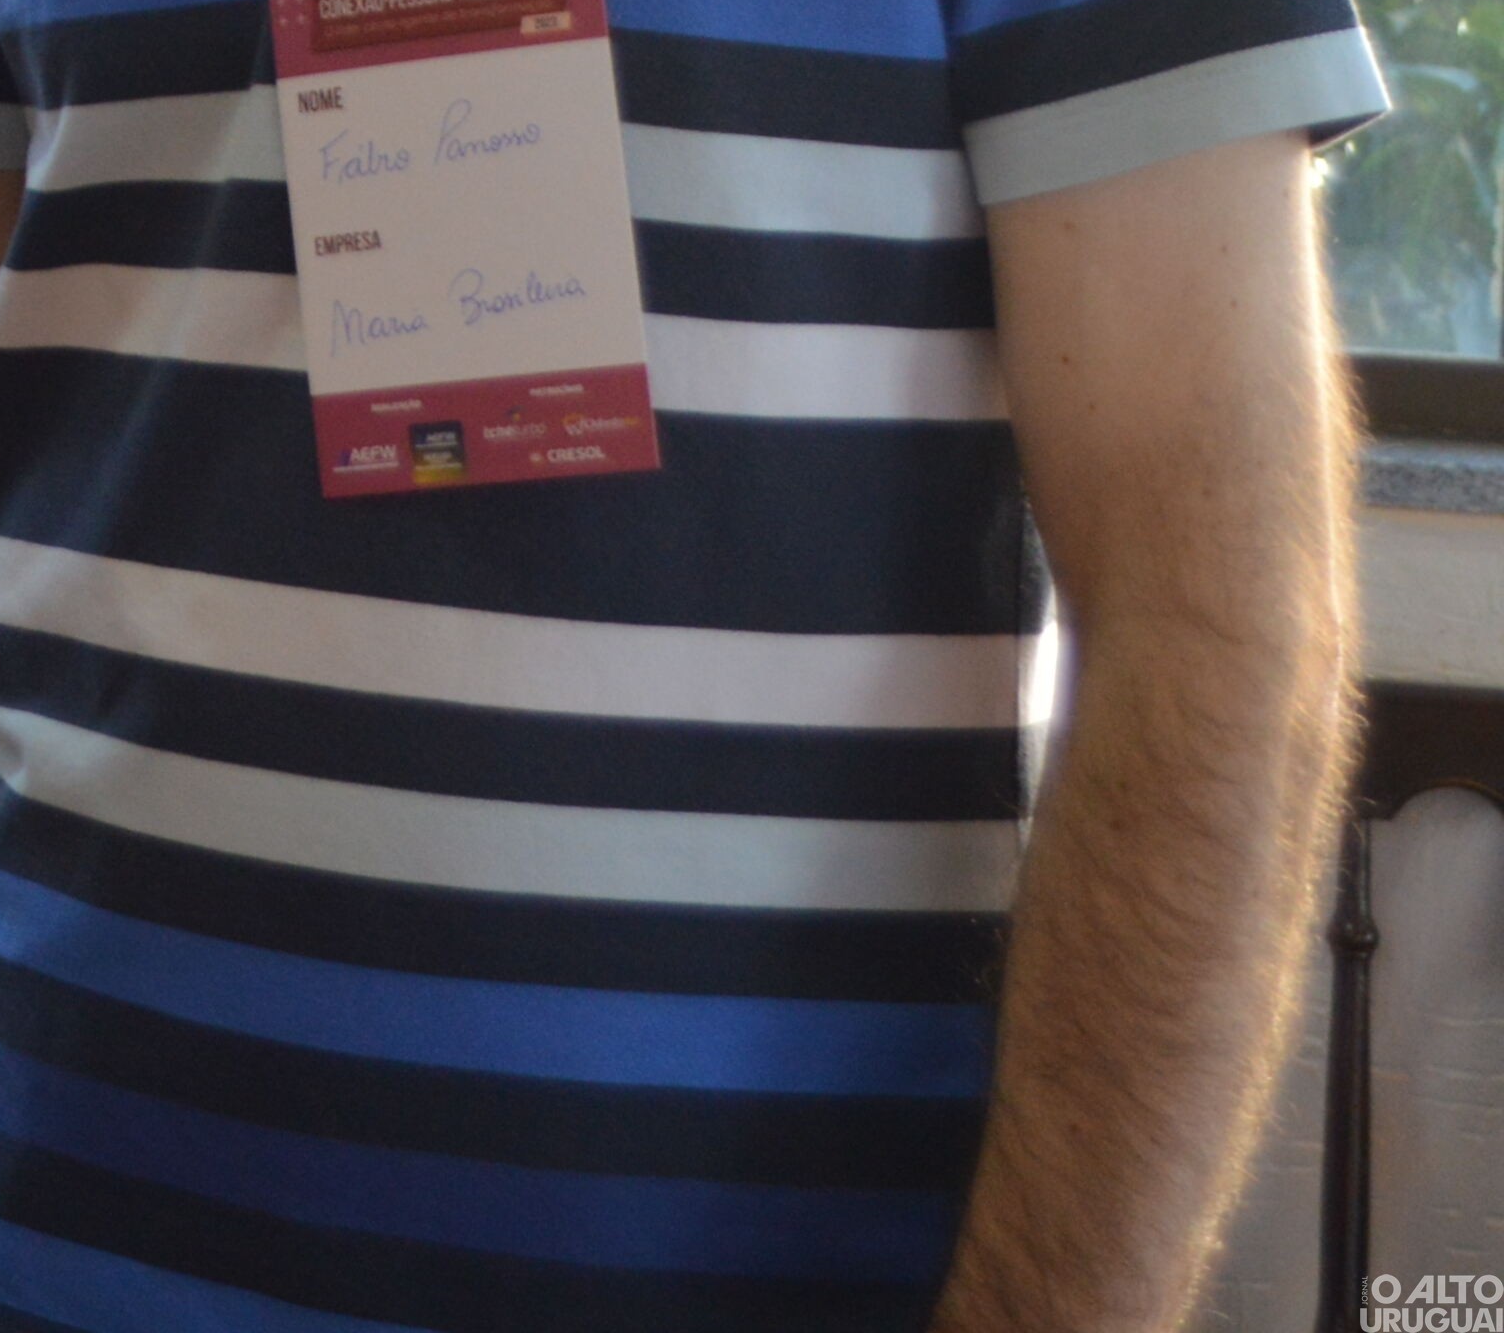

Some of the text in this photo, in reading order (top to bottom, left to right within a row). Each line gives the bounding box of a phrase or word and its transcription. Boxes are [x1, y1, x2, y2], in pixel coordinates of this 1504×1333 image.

[297, 87, 344, 113] NOME
[314, 230, 382, 257] EMPRESA
[547, 445, 606, 462] CRESOL
